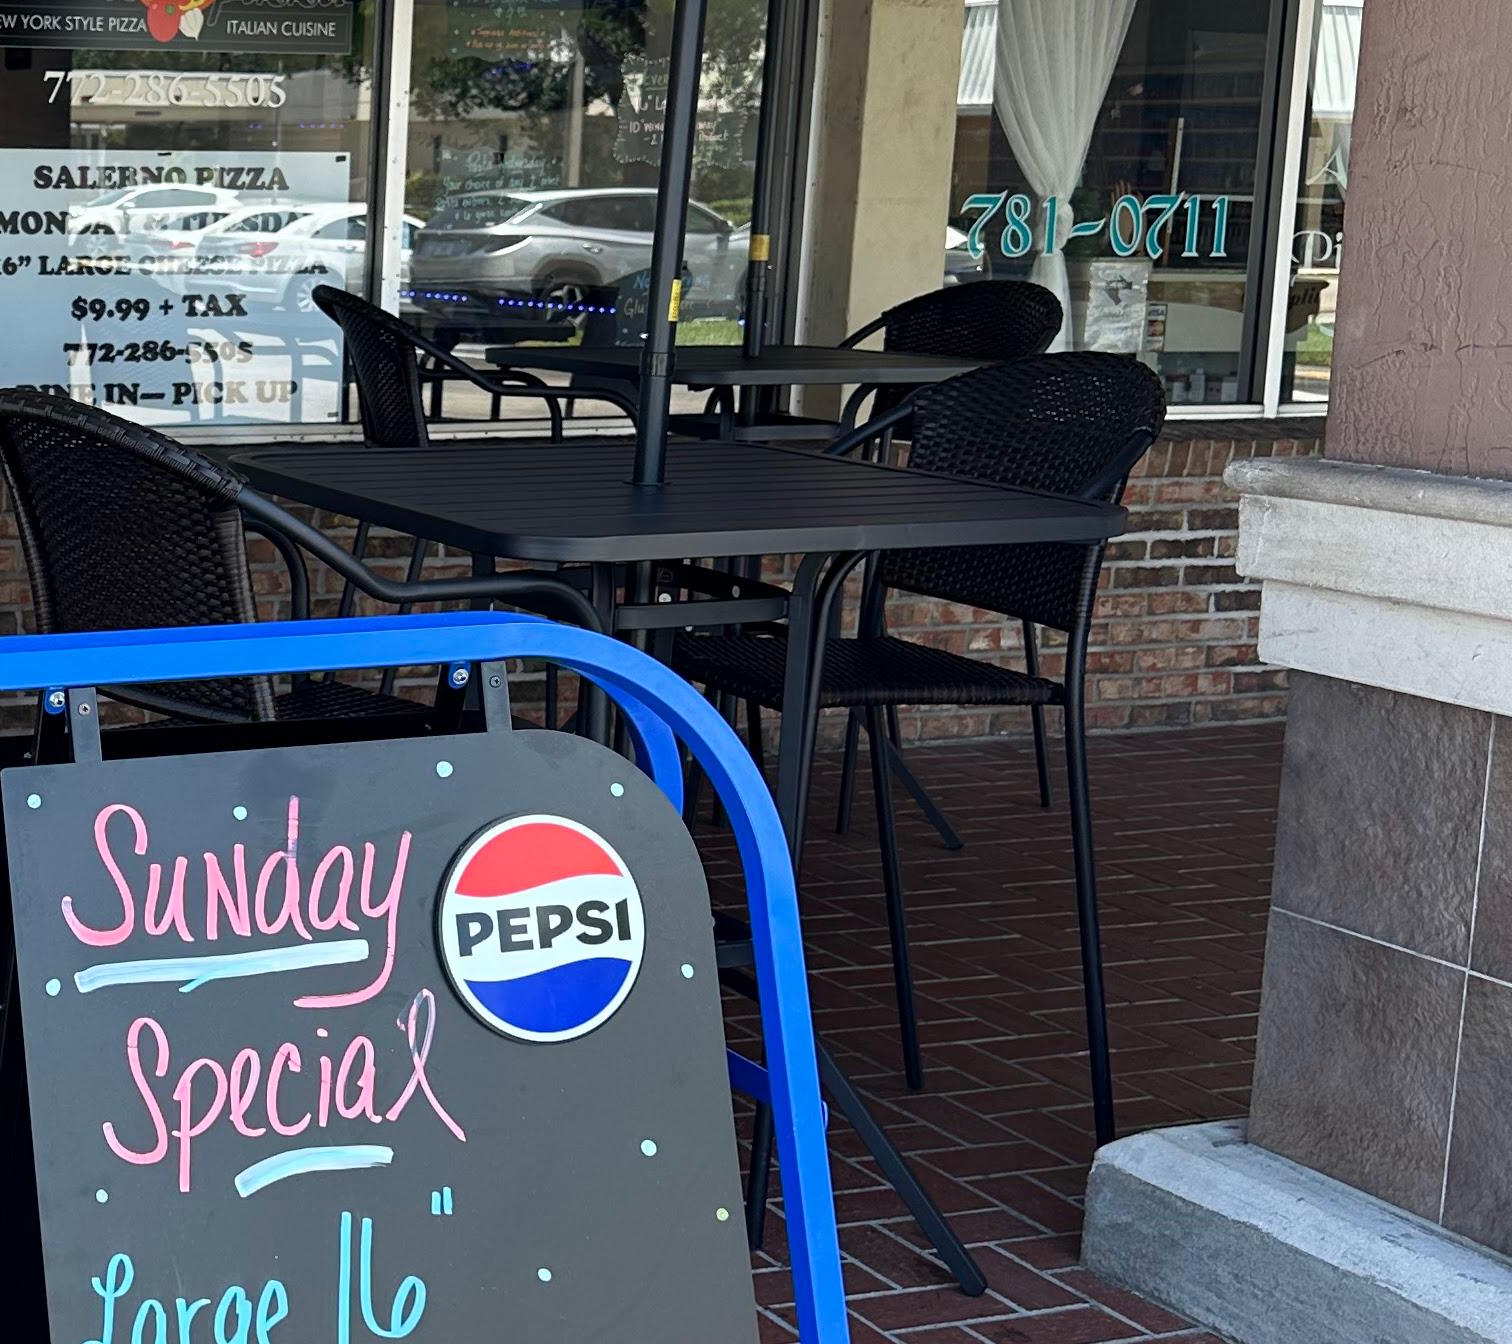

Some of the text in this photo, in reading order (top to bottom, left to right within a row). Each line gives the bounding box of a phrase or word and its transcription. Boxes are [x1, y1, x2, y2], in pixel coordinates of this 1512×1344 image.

[20, 14, 62, 31] YORK
[64, 16, 104, 32] STYLE
[107, 17, 148, 33] PIZZA
[226, 19, 277, 36] ITALIAN
[281, 20, 337, 38] CUISINE
[43, 70, 287, 108] 772-286-5505
[33, 165, 289, 191] SALERNO PIZZA
[960, 190, 1228, 259] 781-0711
[38, 255, 132, 276] LARGE
[71, 294, 248, 322] $9.99 + TAX
[63, 340, 253, 366] 772-286-5505
[172, 382, 248, 406] PICK
[256, 381, 298, 404] UP
[62, 795, 412, 1008] Sunday
[455, 897, 633, 958] PEPSI
[102, 988, 467, 1193] Special
